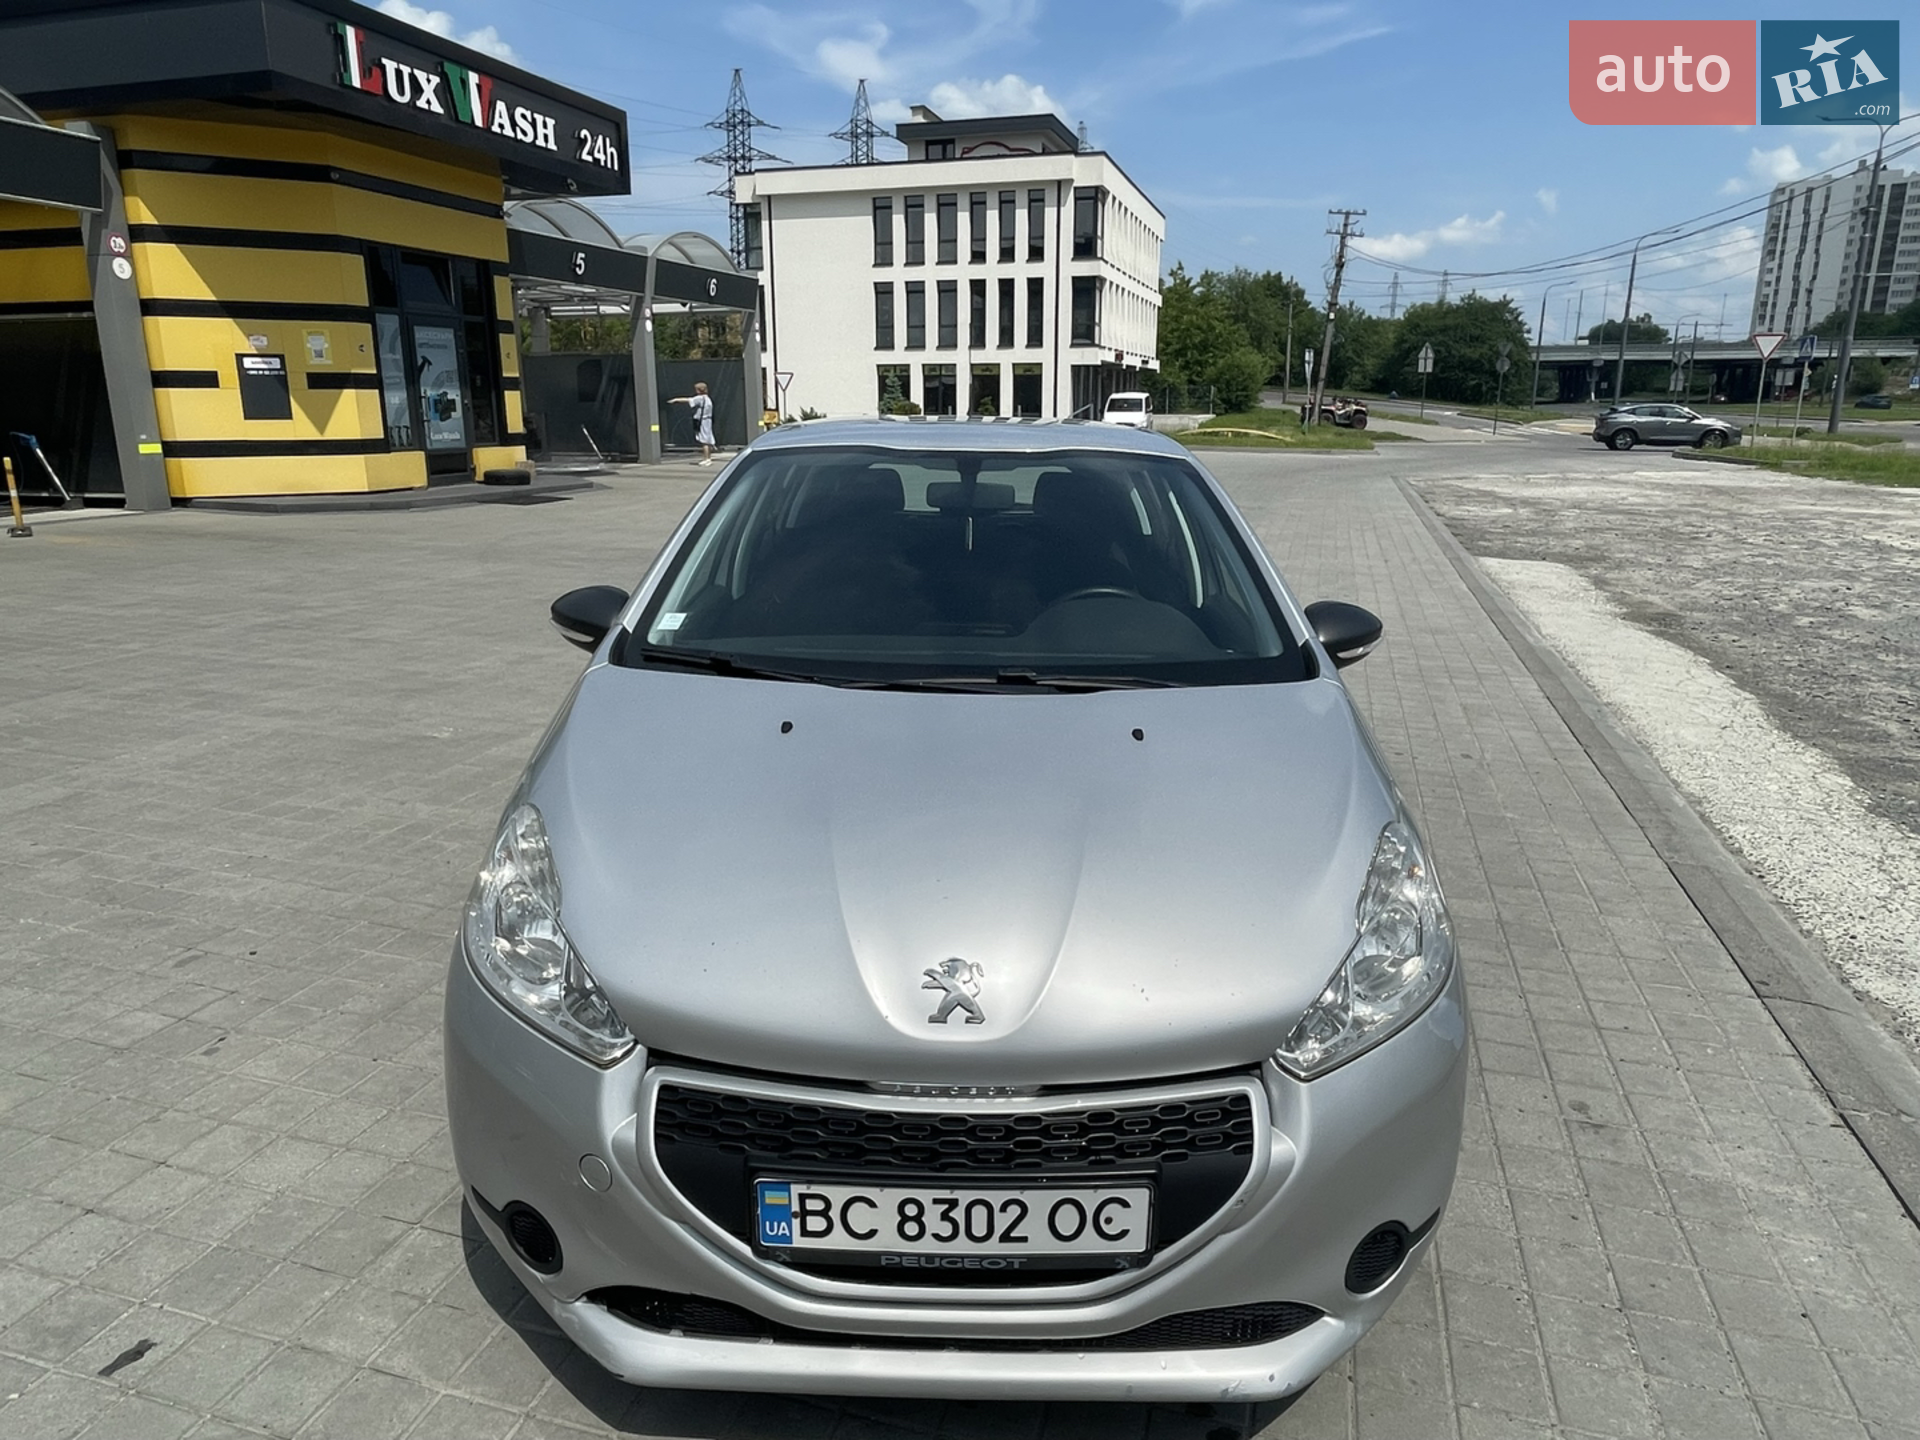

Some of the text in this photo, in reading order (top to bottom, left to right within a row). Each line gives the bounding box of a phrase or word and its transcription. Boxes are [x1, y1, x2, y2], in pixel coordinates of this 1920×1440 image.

[579, 128, 619, 171] 24h
[574, 252, 586, 275] 5
[709, 278, 718, 297] 6
[765, 1220, 790, 1237] UA
[798, 1192, 1132, 1244] BC 8302 OC
[880, 1255, 1028, 1269] PEUGEOT
